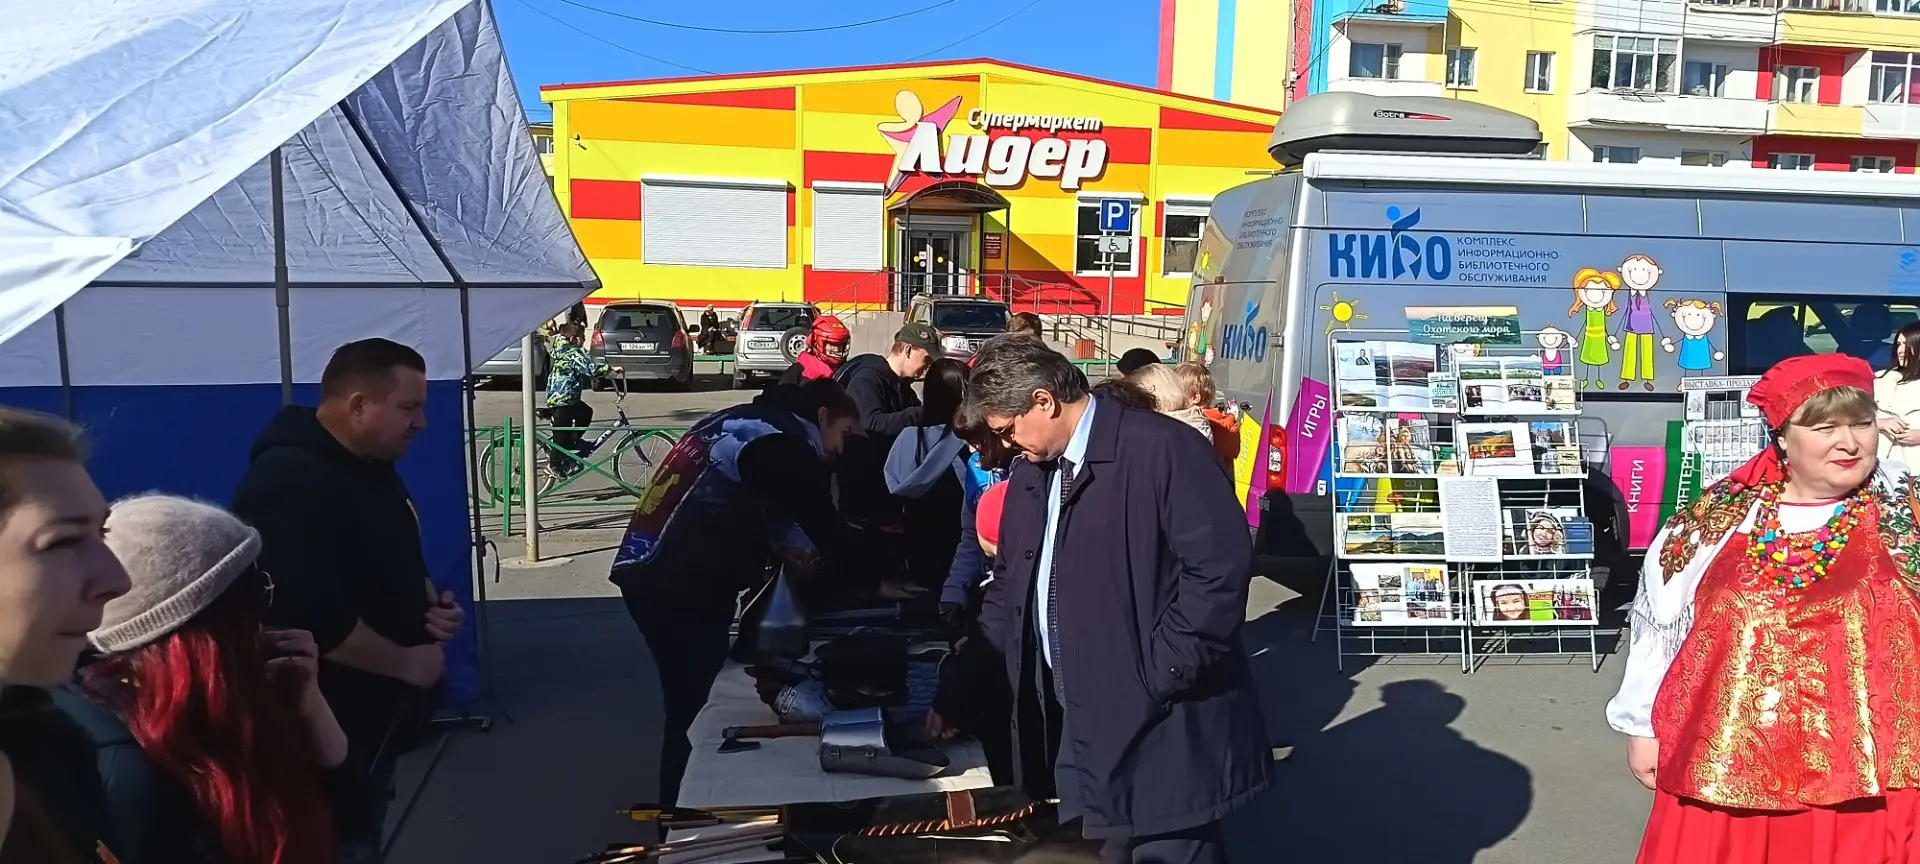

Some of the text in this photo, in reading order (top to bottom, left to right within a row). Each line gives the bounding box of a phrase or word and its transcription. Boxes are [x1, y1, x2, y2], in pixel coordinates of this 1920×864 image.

[967, 108, 1101, 131] Супермаркет
[899, 121, 1108, 189] Лидер
[1107, 202, 1124, 228] P
[1457, 236, 1516, 247] КОМПЛЕКС
[1457, 249, 1562, 260] ИНФОРМАЦИОННО-
[1458, 260, 1550, 272] БИБЛИОТЕЧНОГО
[1458, 273, 1547, 284] ОБСЛУЖИВАНИЯ
[1438, 313, 1488, 326] На берегу
[1423, 323, 1510, 337] Охотского моря
[1301, 394, 1328, 439] ИГРЫ
[1628, 460, 1645, 513] КНИГИ
